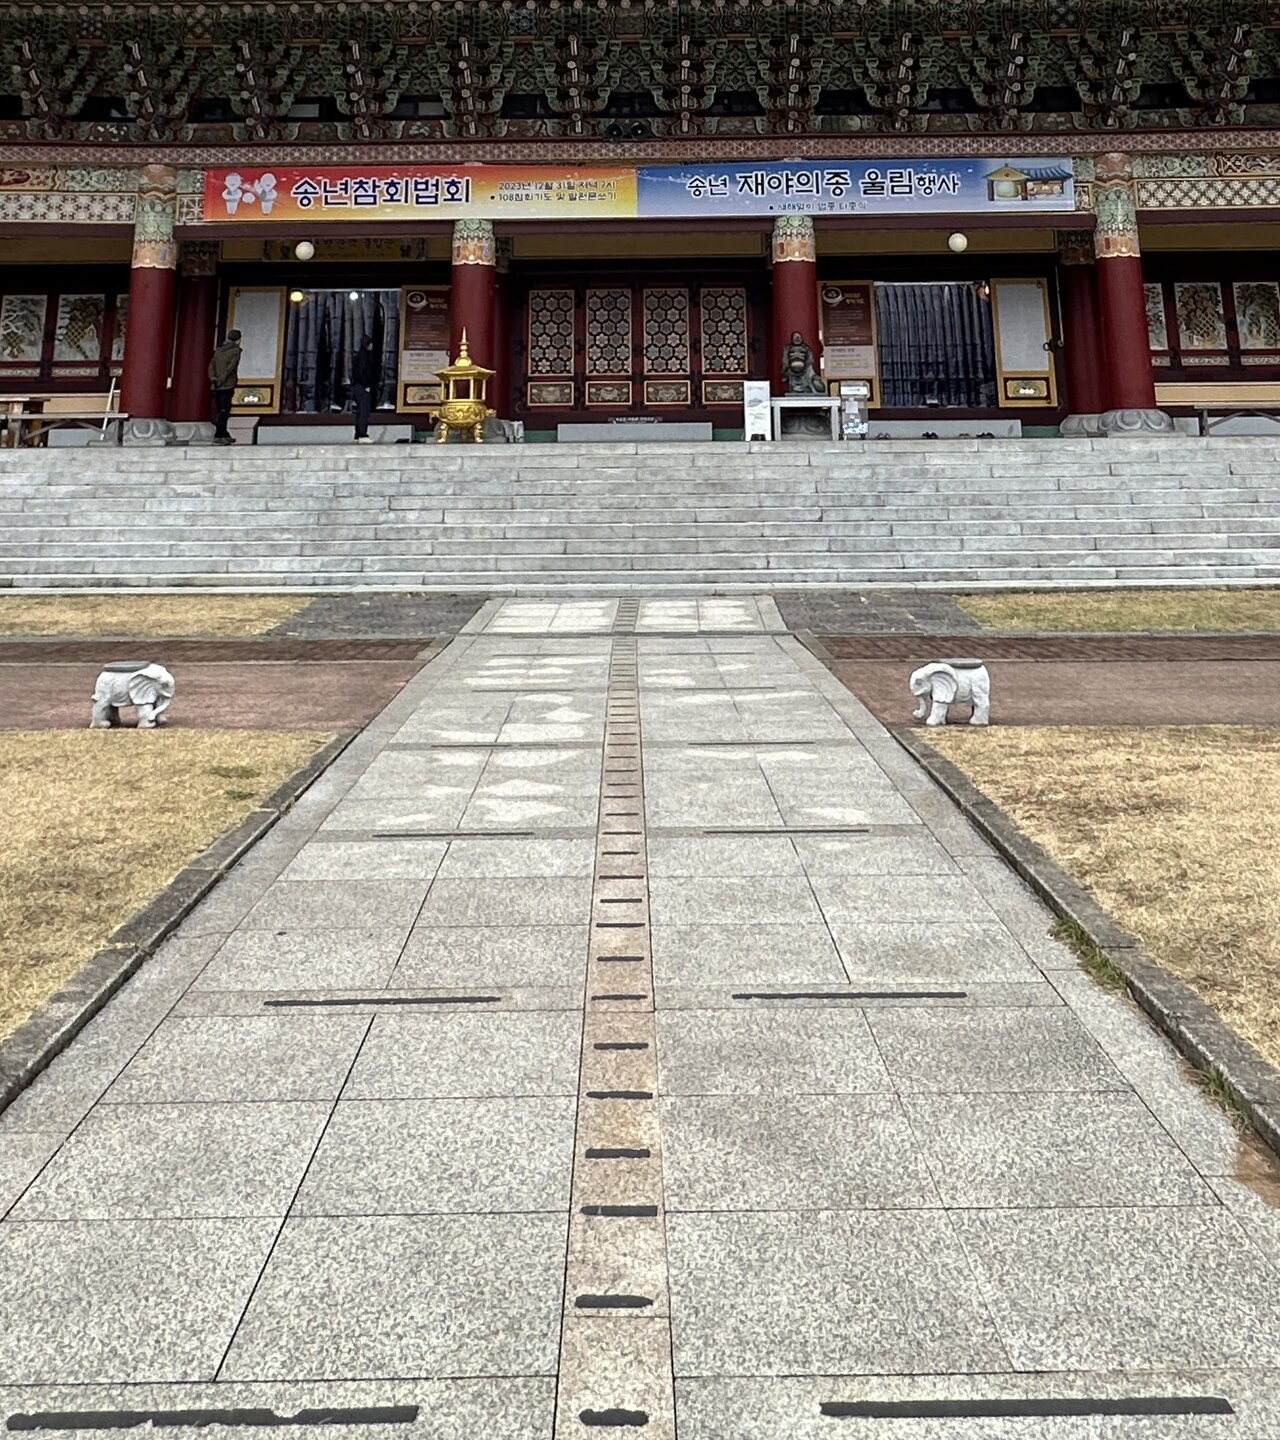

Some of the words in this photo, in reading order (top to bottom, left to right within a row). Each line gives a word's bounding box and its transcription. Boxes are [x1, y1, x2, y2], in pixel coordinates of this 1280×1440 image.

[292, 177, 471, 208] 송년참회법회
[499, 181, 531, 191] 2023년
[535, 181, 554, 191] 12월
[556, 181, 575, 190] 31일
[579, 180, 598, 190] 저녁
[601, 180, 616, 189] 7시
[687, 175, 728, 198] 송년
[737, 170, 851, 198] 재야의종
[555, 192, 565, 201] 및
